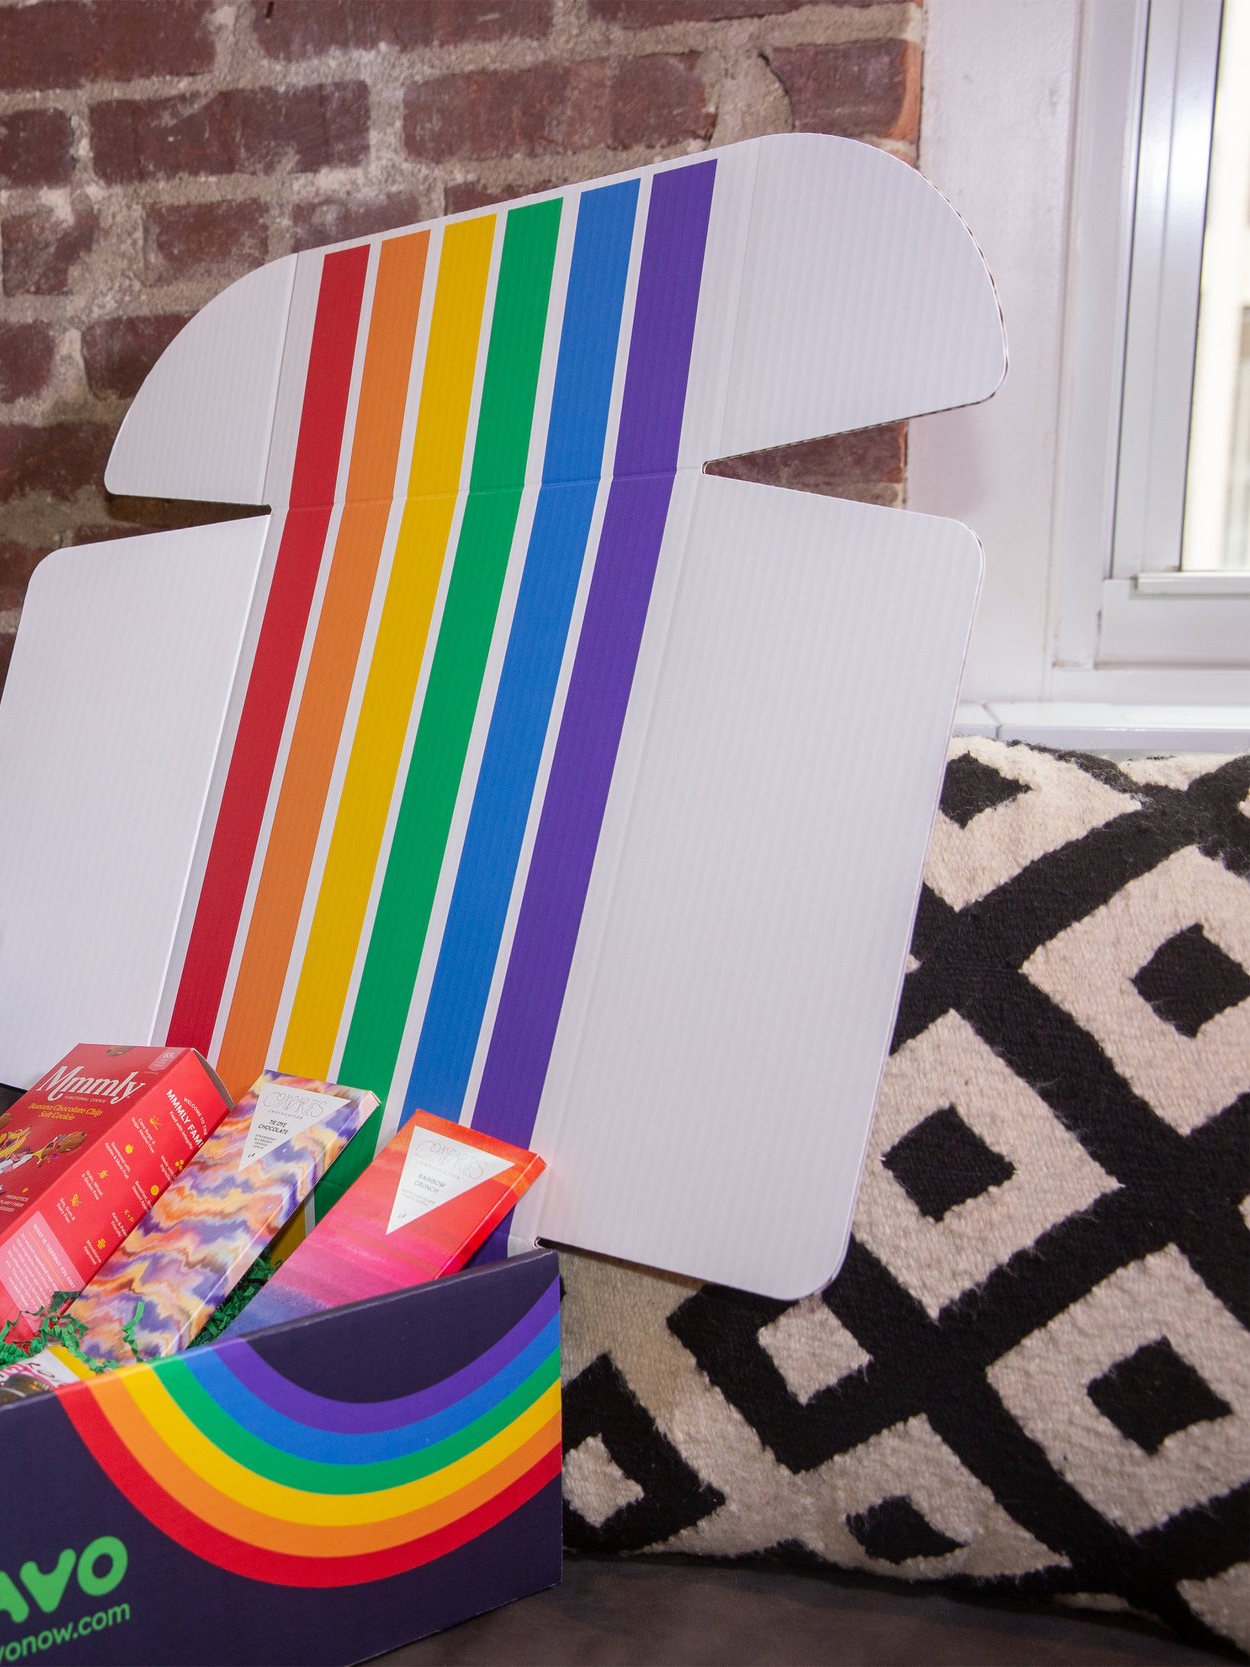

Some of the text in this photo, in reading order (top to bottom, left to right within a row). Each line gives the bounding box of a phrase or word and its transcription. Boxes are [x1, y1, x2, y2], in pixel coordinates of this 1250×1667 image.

[36, 1065, 146, 1105] Mmmly
[53, 1104, 86, 1113] Chocolate
[86, 1108, 102, 1117] Chip
[166, 1089, 191, 1124] MMMLY
[183, 1097, 202, 1117] WELCOME
[199, 1116, 205, 1126] TO
[52, 1112, 75, 1120] Cookie
[170, 1111, 178, 1123] Food
[182, 1131, 193, 1149] Integrity
[258, 1124, 289, 1135] CHOCOLATE
[414, 1180, 440, 1193] CRUNCH
[418, 1173, 446, 1188] RAINBOW
[111, 1220, 121, 1237] Friendly
